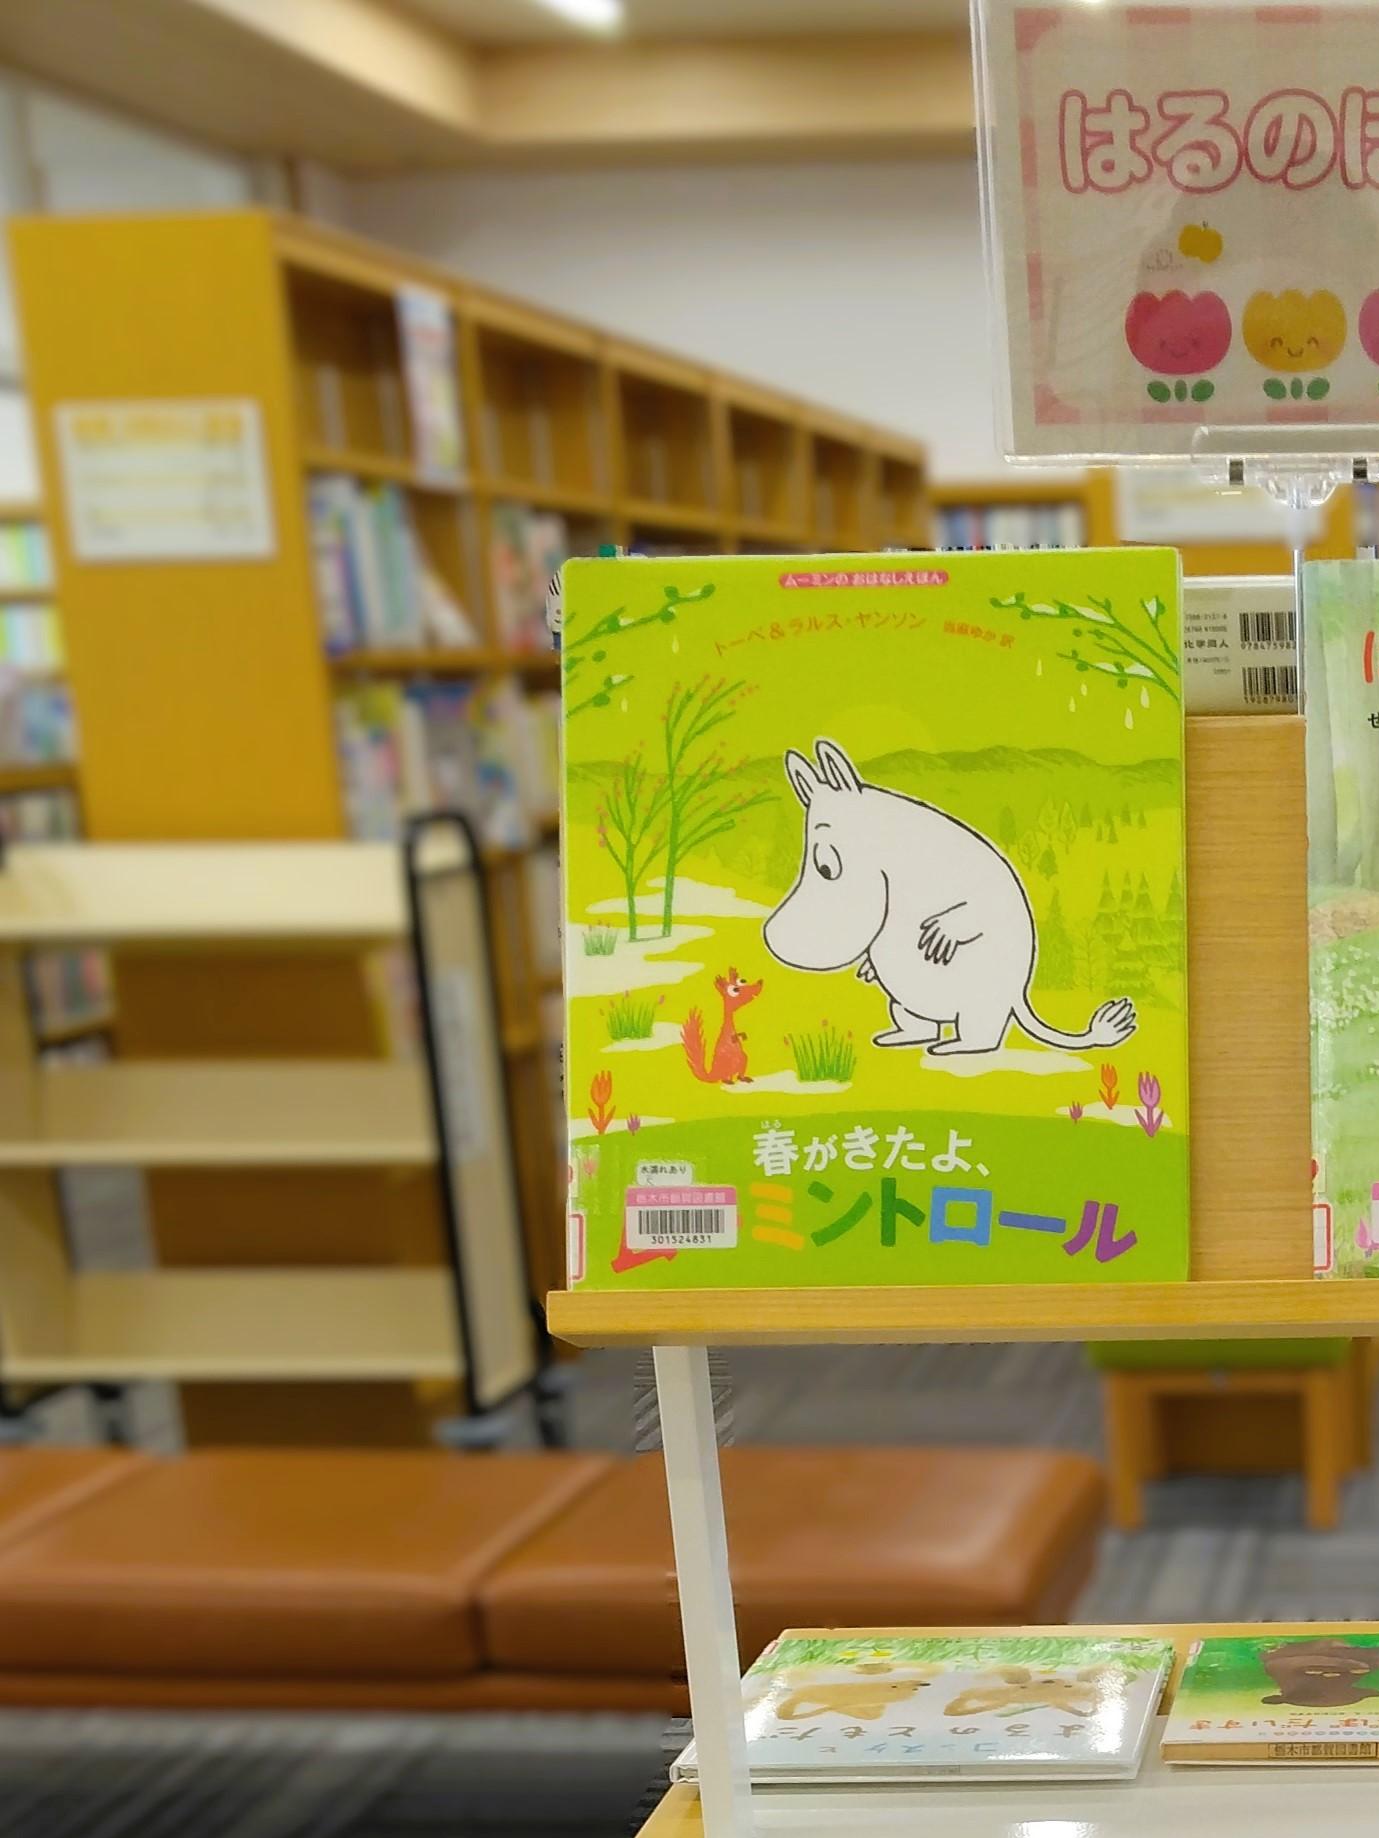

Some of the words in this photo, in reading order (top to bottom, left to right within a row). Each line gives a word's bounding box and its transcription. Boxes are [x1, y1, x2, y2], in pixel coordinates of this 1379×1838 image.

[753, 1126, 991, 1177] 春がきたよ、
